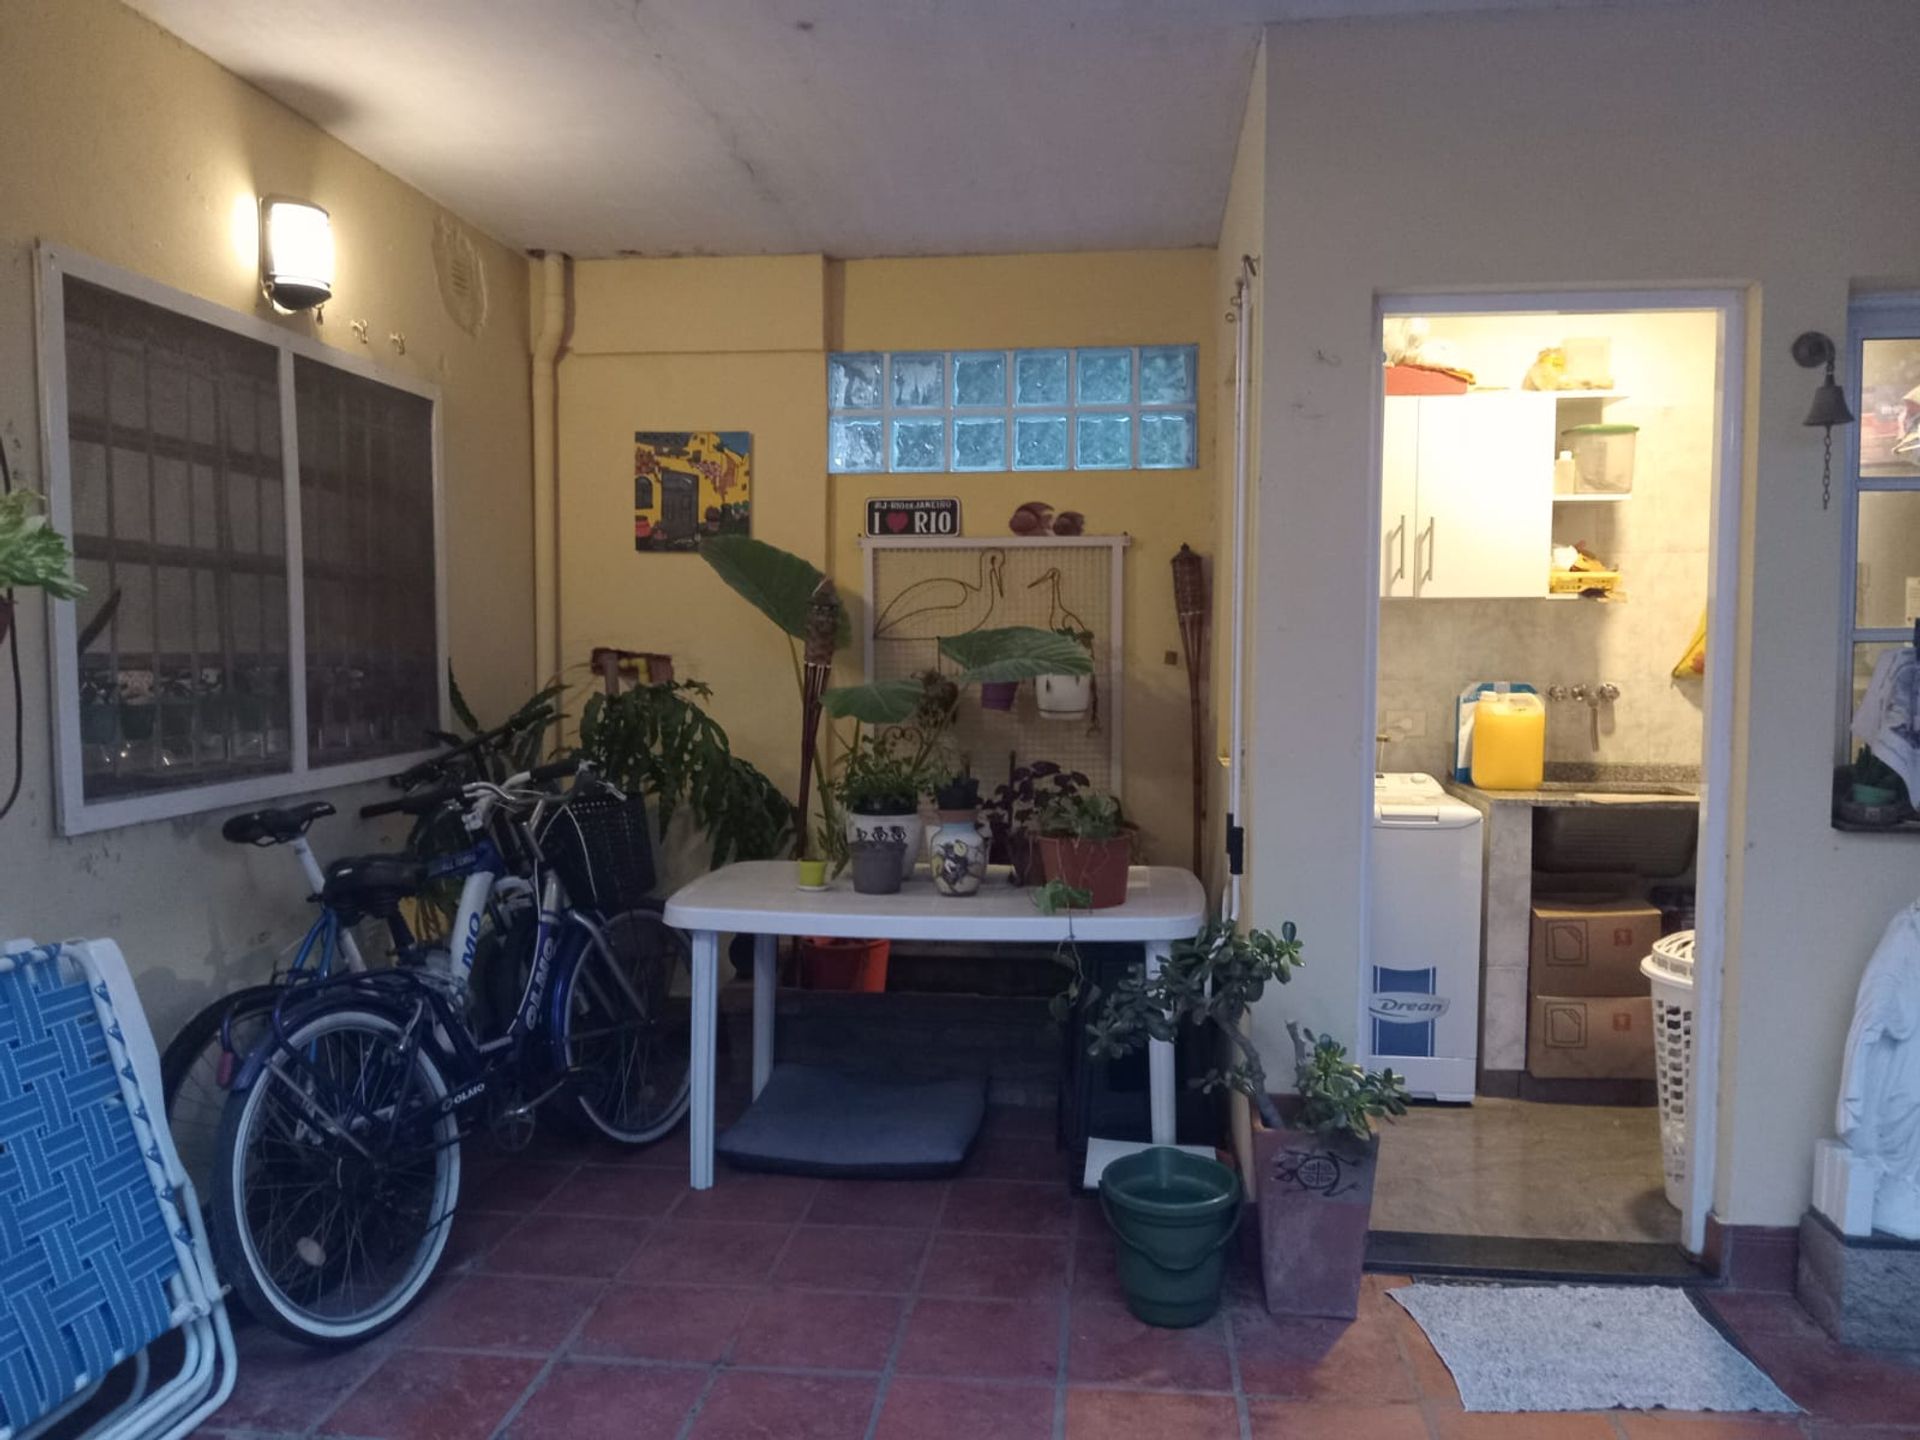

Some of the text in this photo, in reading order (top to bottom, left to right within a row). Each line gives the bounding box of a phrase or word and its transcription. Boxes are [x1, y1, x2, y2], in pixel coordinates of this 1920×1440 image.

[874, 511, 952, 534] I RIO
[525, 937, 554, 1031] OLMO
[1378, 998, 1443, 1012] Drean
[453, 1082, 486, 1104] OLMO
